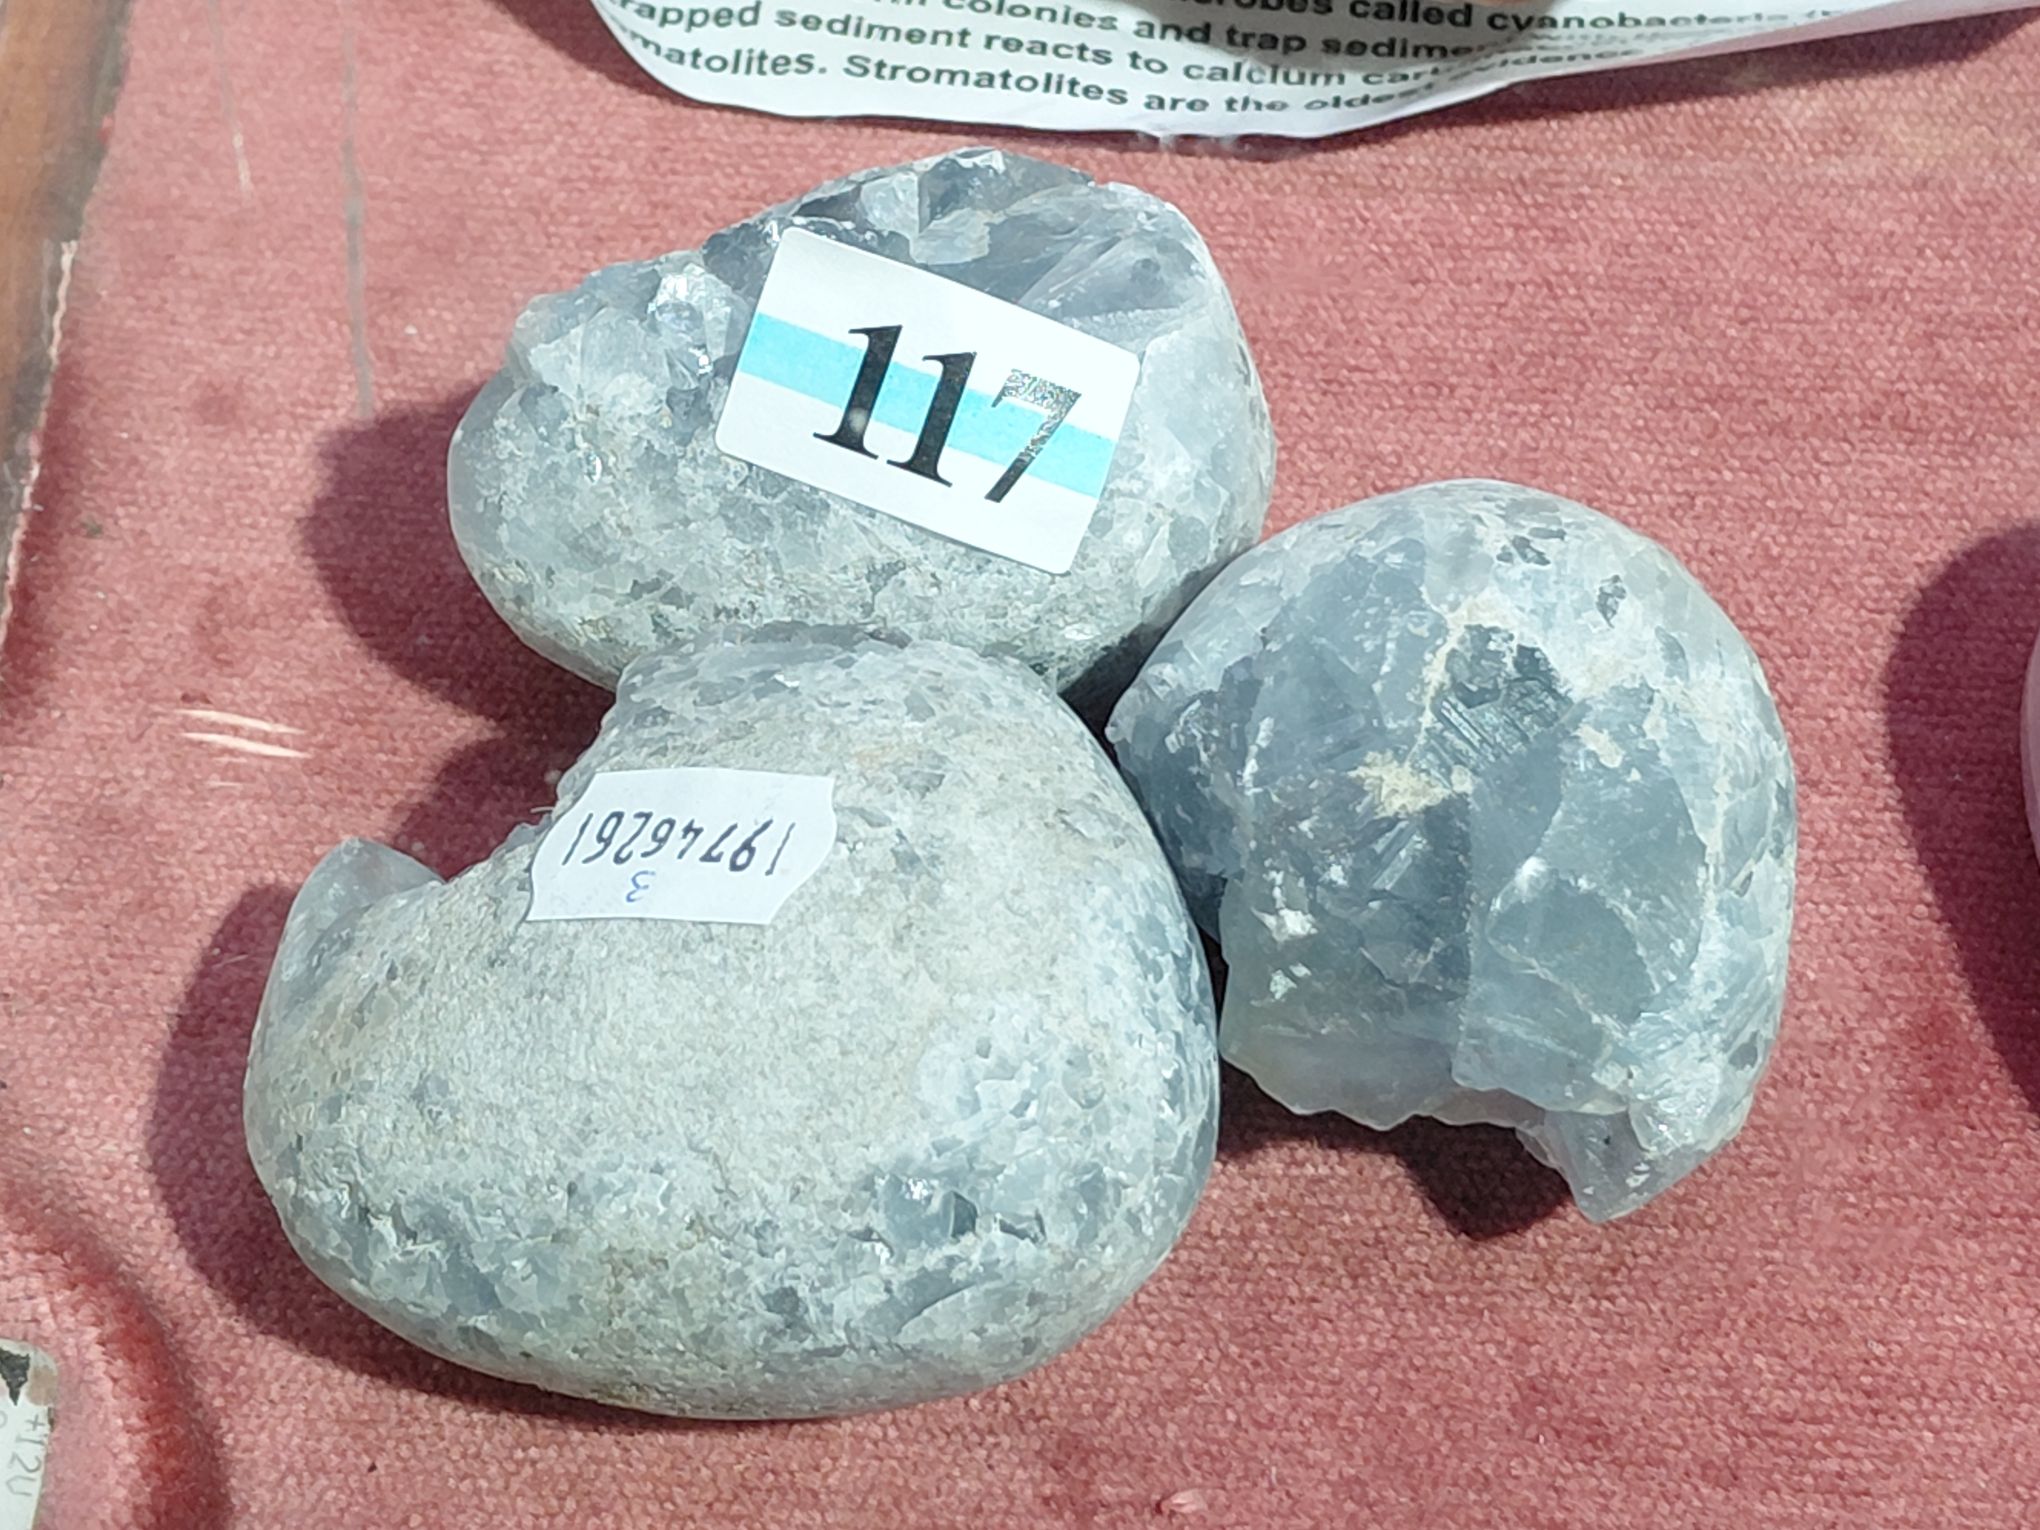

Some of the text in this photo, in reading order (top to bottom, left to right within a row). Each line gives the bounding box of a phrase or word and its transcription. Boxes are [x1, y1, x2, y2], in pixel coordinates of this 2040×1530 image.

[942, 0, 1118, 31] colonies
[1133, 20, 1211, 44] and
[1226, 23, 1307, 55] trap
[1350, 0, 1473, 27] called
[774, 9, 972, 48] sediment
[983, 33, 1113, 65] reacts
[1128, 49, 1169, 74] to
[1183, 59, 1345, 86] calcium
[843, 53, 1129, 105] Stromatolites
[1144, 93, 1210, 112] are
[1225, 95, 1290, 112] the
[813, 325, 1082, 504] 117
[562, 811, 796, 877] 19746261
